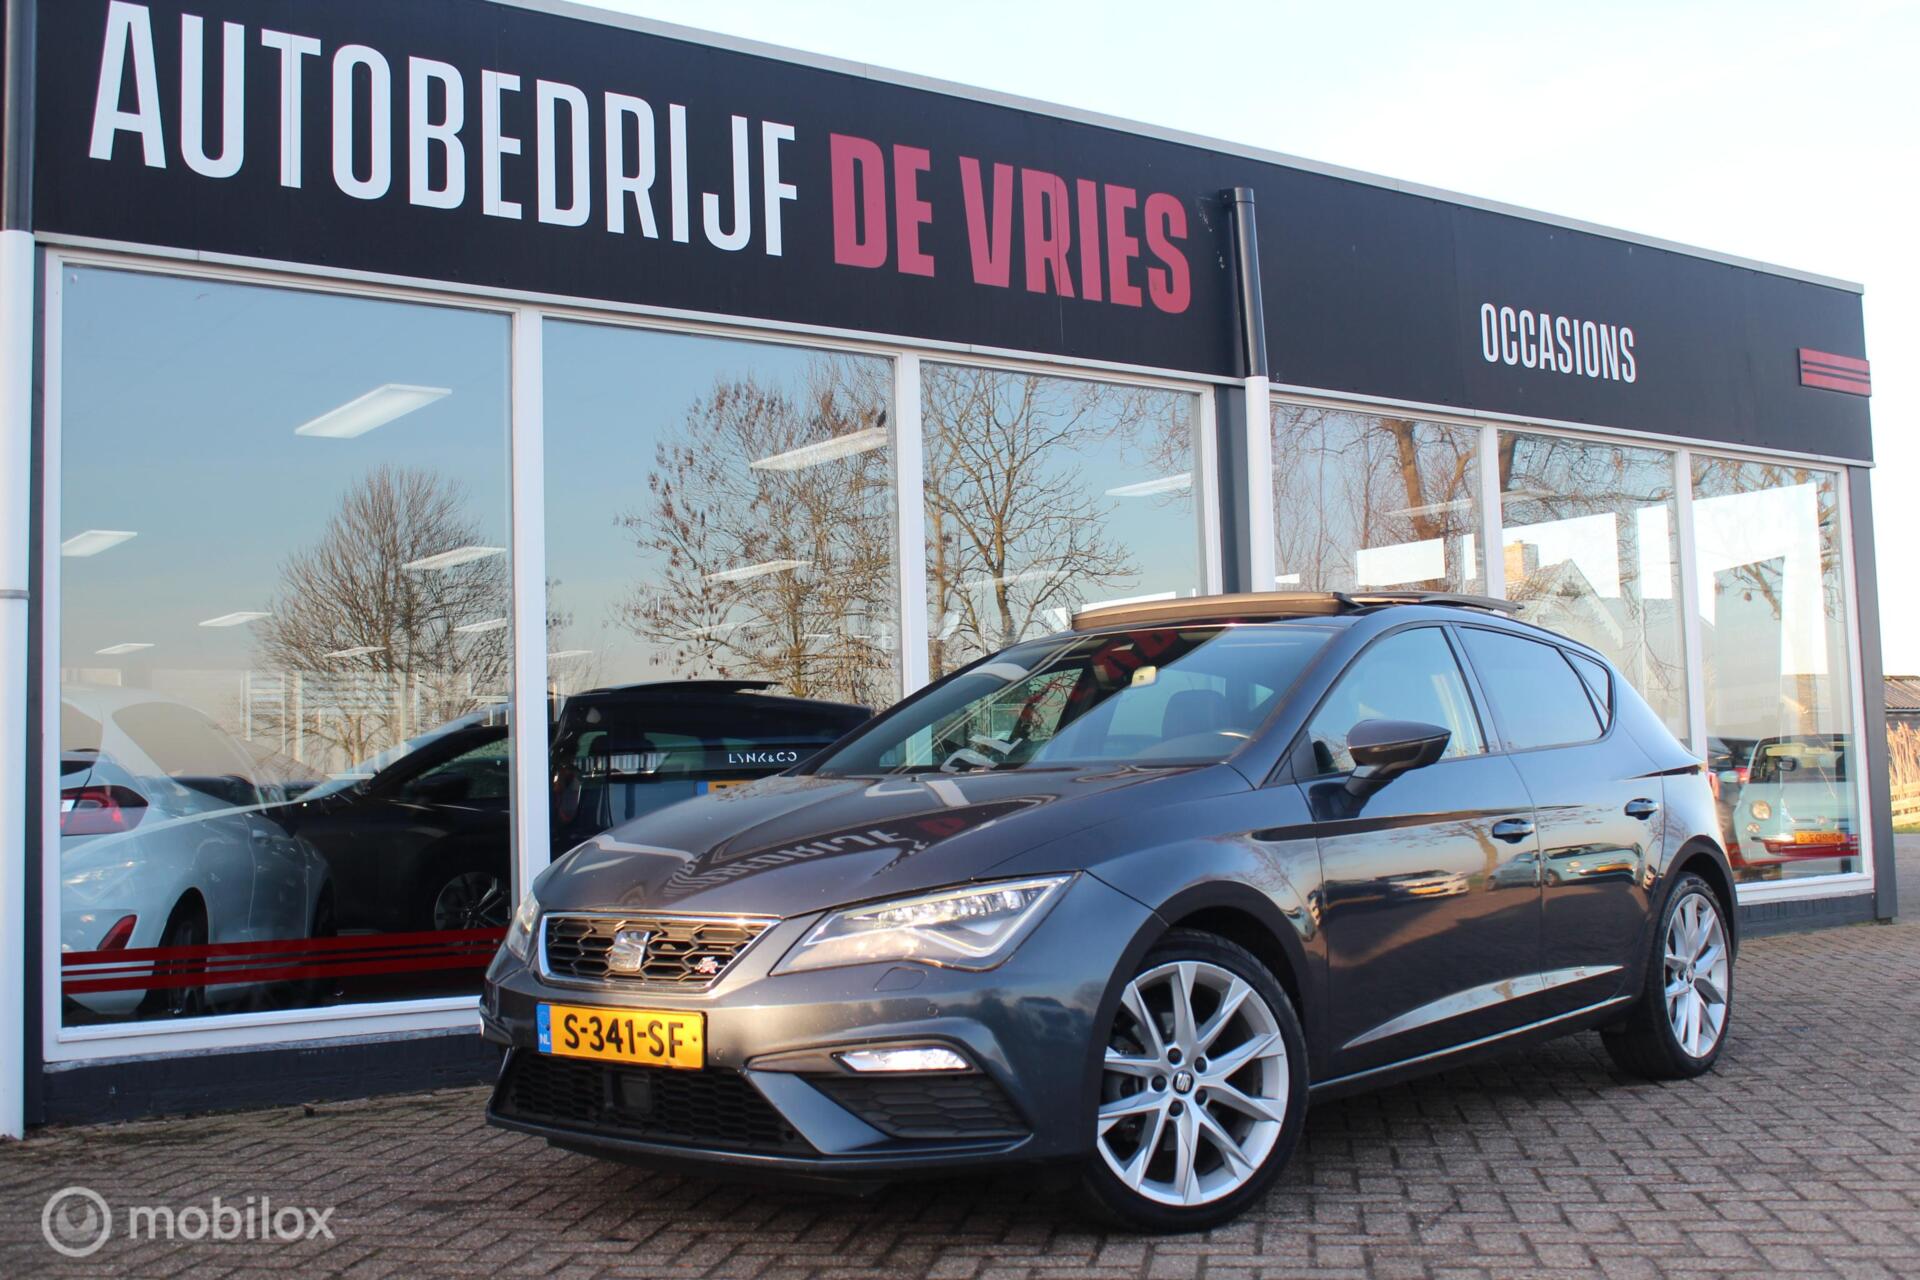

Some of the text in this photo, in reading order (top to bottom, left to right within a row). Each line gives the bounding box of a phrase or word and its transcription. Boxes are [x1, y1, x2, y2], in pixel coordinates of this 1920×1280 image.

[89, 0, 1191, 314] AUTOBEDRIJF DE VRIES
[1481, 303, 1636, 383] OCCASIONS
[539, 1014, 684, 1058] NL S-341-SF
